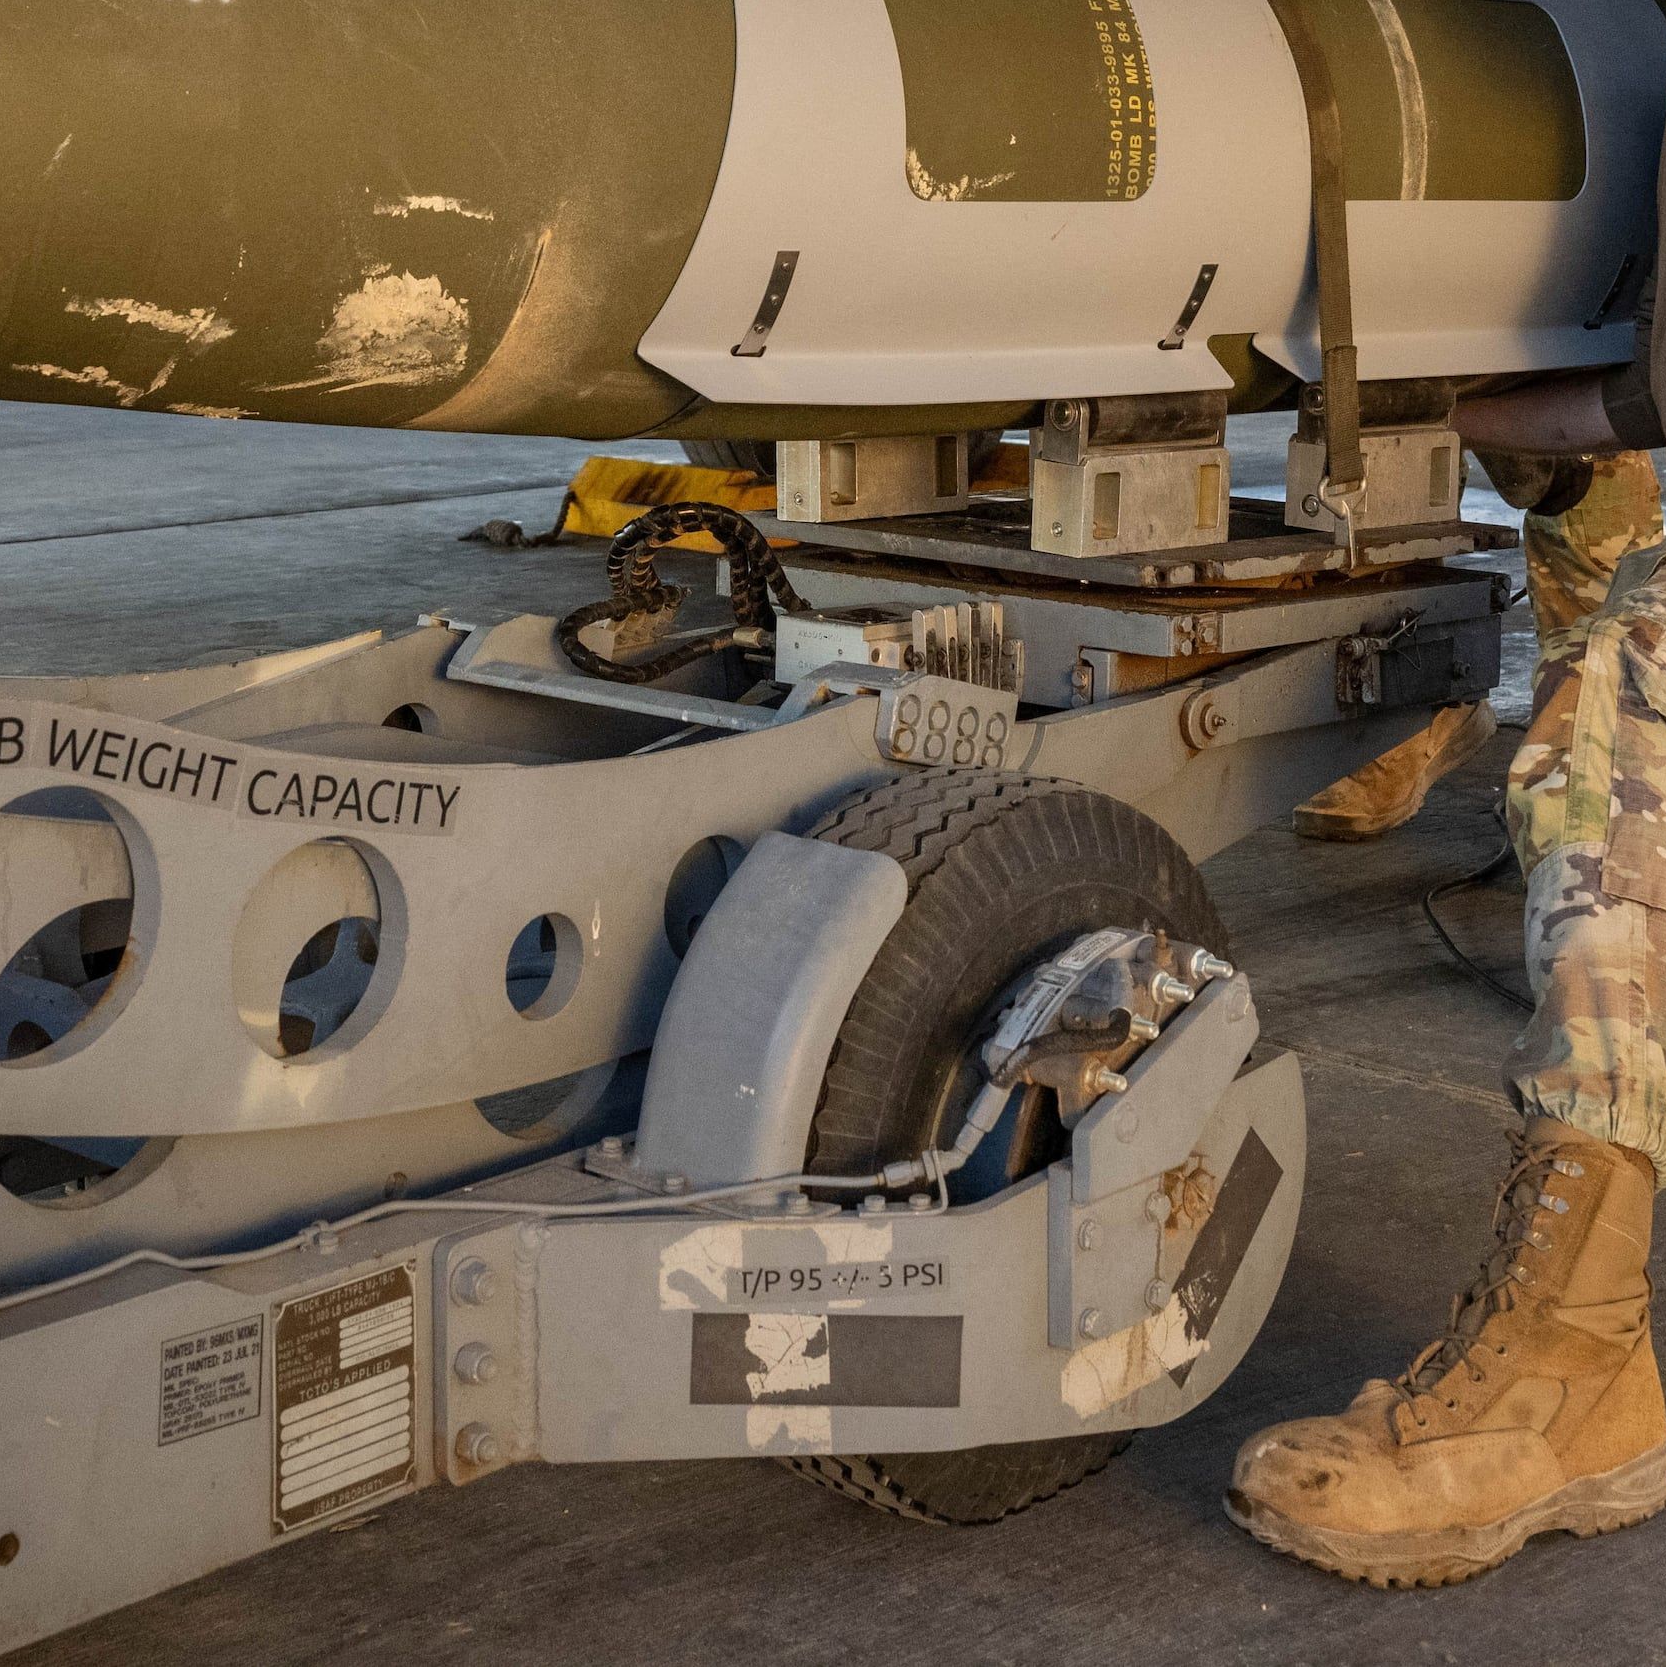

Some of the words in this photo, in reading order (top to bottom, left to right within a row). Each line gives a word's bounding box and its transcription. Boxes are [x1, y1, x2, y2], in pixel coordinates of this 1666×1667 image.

[1115, 20, 1131, 43] 84
[1122, 53, 1140, 84] MK
[1096, 21, 1123, 198] 1325-01-033-9895
[1129, 95, 1142, 123] LD
[1125, 134, 1142, 199] BOMB
[46, 718, 238, 804] WEIGHT
[246, 769, 462, 829] CAPACITY
[741, 1268, 781, 1299] T/P
[790, 1268, 823, 1292] 95
[878, 1265, 893, 1288] 5
[903, 1263, 944, 1287] PSI
[331, 1304, 343, 1318] LB
[343, 1291, 381, 1313] CAPACITY
[164, 1341, 194, 1362] PAINTED
[164, 1363, 184, 1381] DATE
[222, 1350, 233, 1365] 23
[234, 1346, 249, 1361] JUL
[251, 1342, 260, 1356] 21
[299, 1377, 340, 1402] TCTO'S
[343, 1359, 392, 1385] APPLIED
[338, 1478, 384, 1506] PROPERTY
